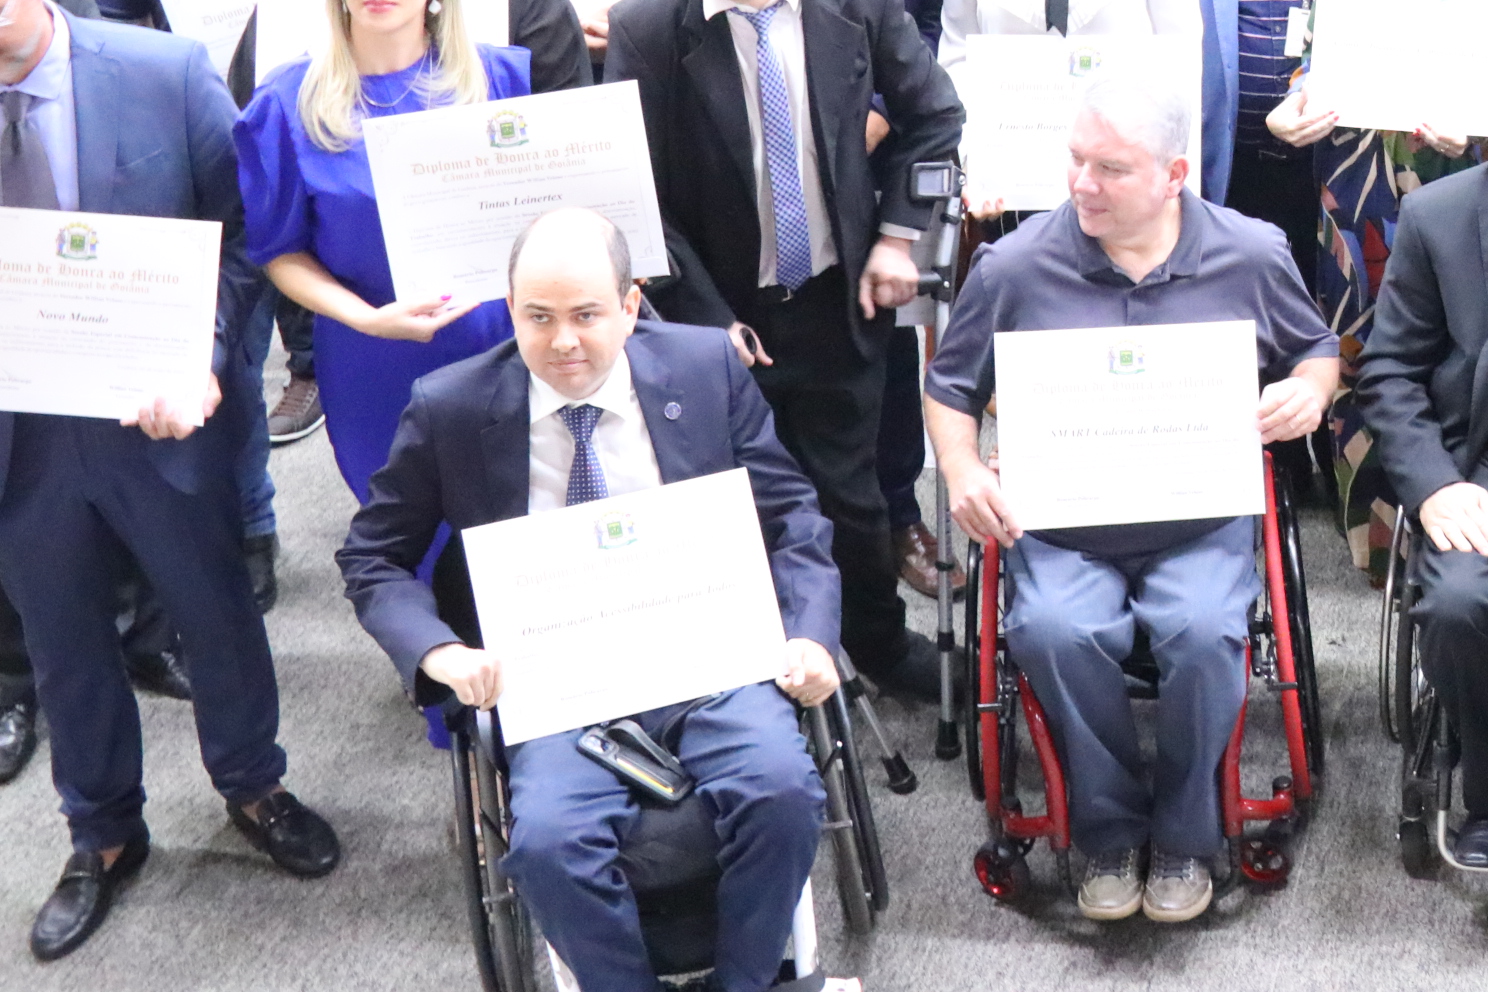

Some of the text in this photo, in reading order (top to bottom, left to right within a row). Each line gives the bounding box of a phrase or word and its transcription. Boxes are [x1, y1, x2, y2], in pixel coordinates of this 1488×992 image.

[410, 159, 471, 176] Diploma
[475, 155, 490, 168] de
[543, 148, 560, 159] ao
[564, 140, 612, 158] Mérito
[478, 192, 563, 211] Tintas Leinertex
[37, 261, 51, 274] de
[109, 270, 124, 280] ao
[36, 309, 109, 325] Novo Mundo
[1050, 426, 1090, 438] SMART
[1094, 425, 1134, 437] Cadeira
[1137, 424, 1150, 435] de
[1152, 422, 1183, 434] Rodas
[520, 613, 594, 638] Organização
[676, 587, 702, 605] para
